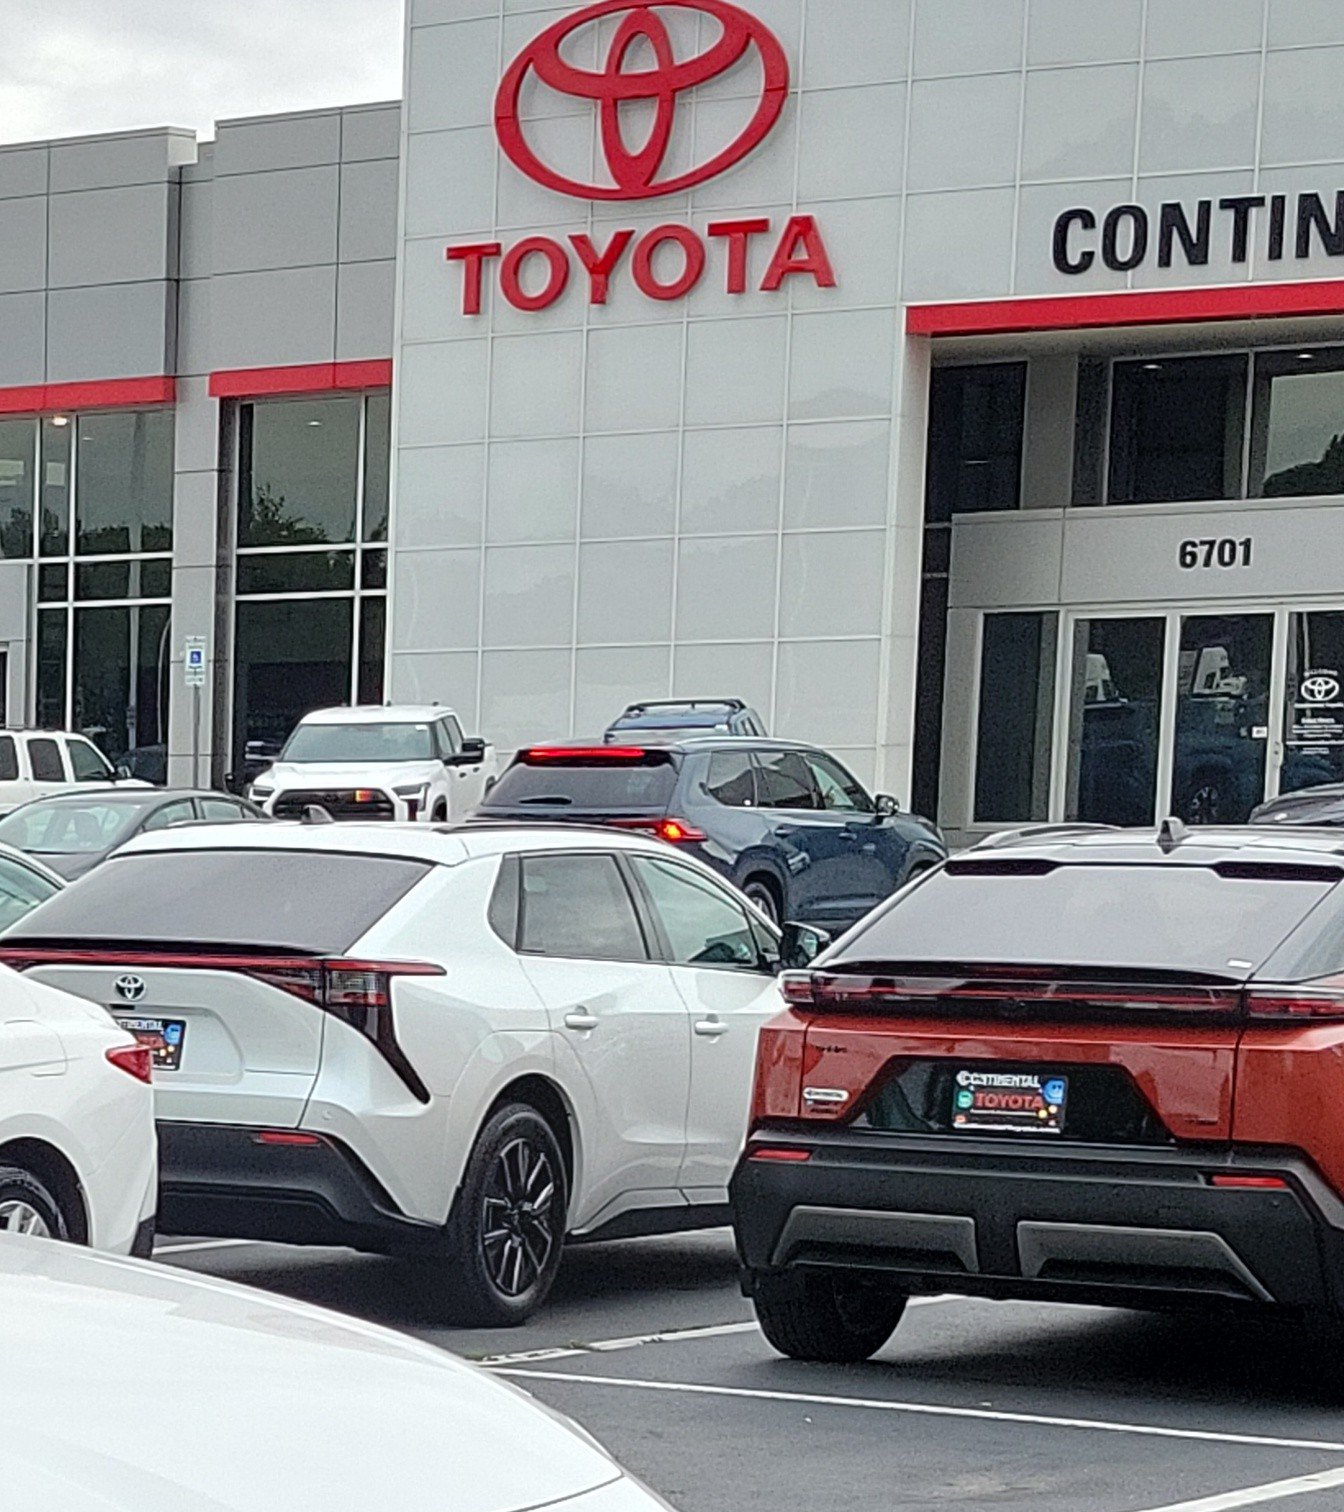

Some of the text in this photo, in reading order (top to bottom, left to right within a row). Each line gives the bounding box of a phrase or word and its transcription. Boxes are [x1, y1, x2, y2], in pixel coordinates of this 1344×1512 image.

[1053, 190, 1344, 275] CONTIN
[446, 214, 838, 316] TOYOTA
[1179, 537, 1252, 569] 6701
[974, 1092, 1045, 1109] TOYOTA
